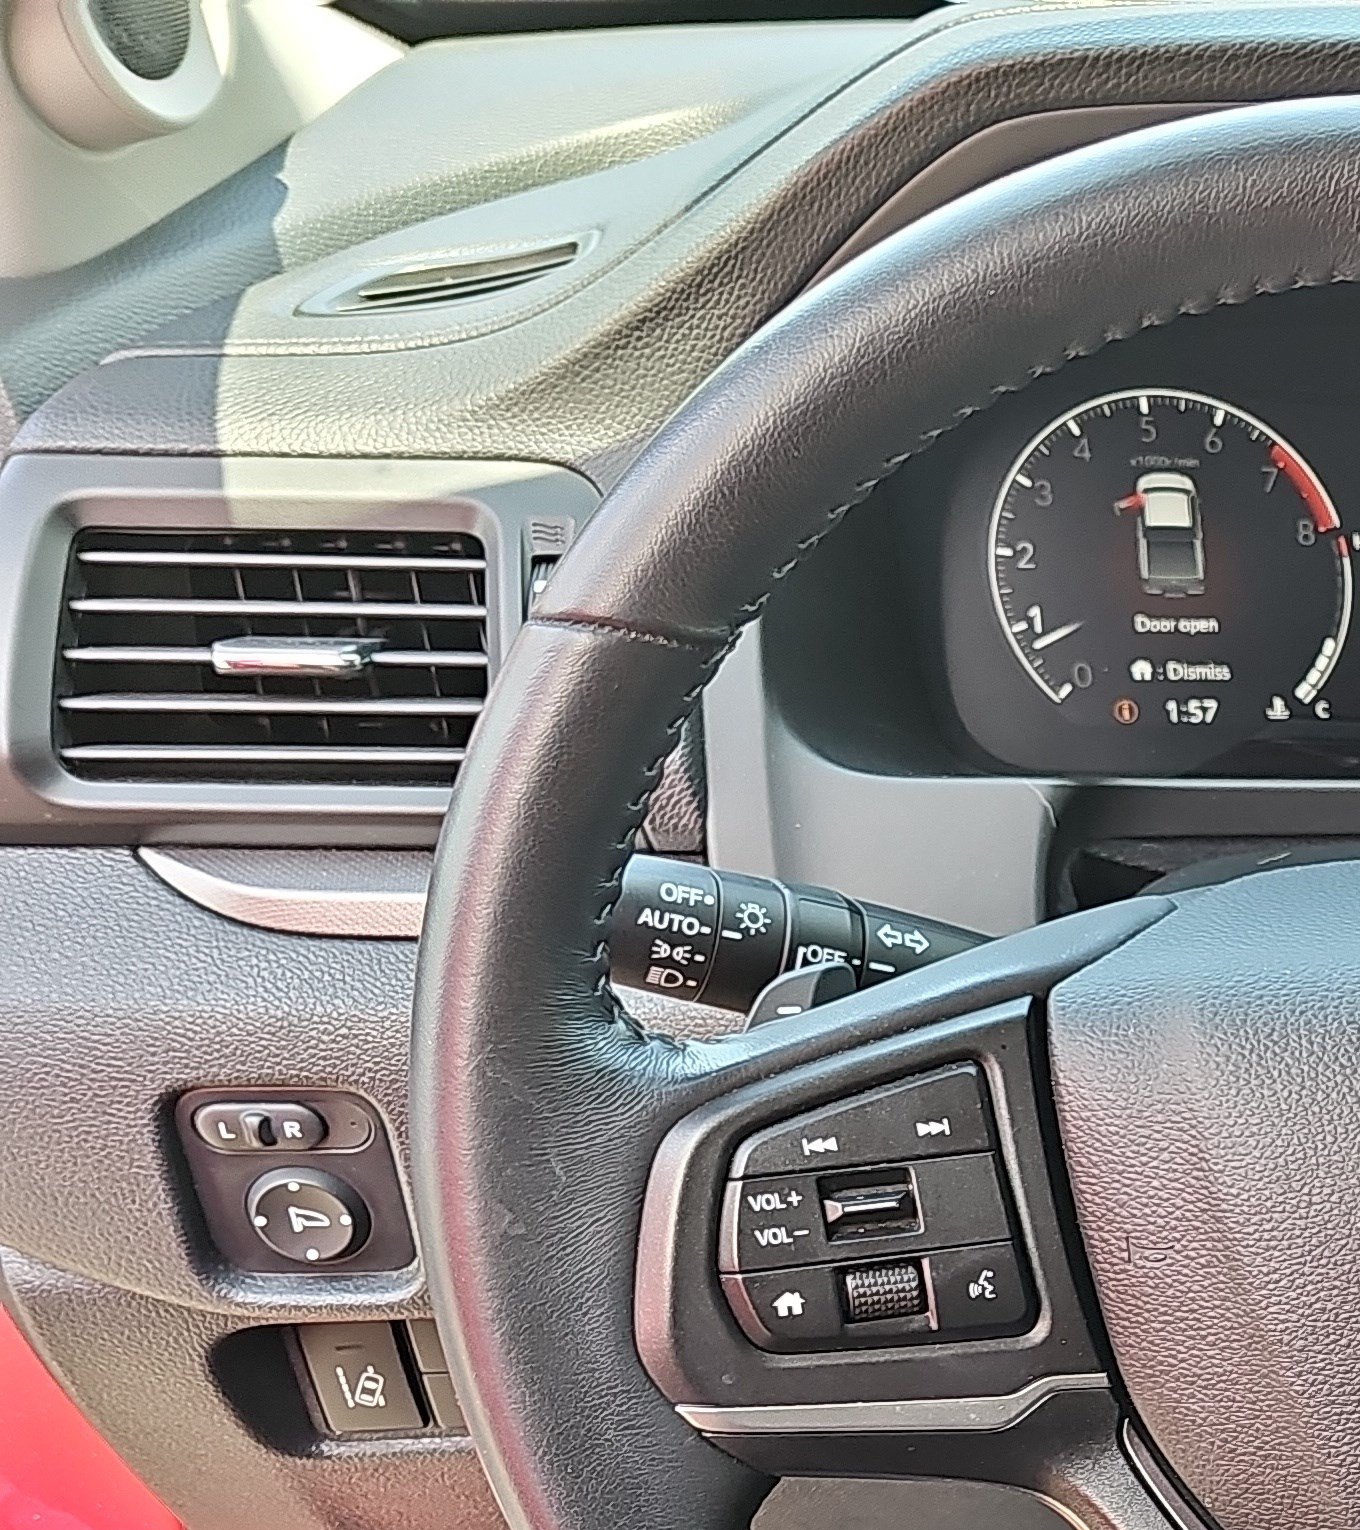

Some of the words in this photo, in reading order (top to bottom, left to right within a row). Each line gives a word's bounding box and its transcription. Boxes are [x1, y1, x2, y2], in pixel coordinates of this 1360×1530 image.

[1141, 418, 1157, 441] 5
[1073, 439, 1092, 461] 4
[1204, 431, 1223, 454] 6
[1261, 468, 1279, 493] 7
[1033, 482, 1053, 505] 3
[1297, 520, 1316, 546] 8
[1016, 543, 1037, 569] 2
[1026, 606, 1043, 633] 1
[1134, 614, 1175, 634] Door
[1178, 617, 1219, 637] open
[1073, 664, 1092, 687] 0
[1166, 661, 1233, 682] Dismiss
[1165, 699, 1220, 725] 1:57
[1315, 700, 1332, 719] C
[659, 882, 703, 905] OFF
[637, 908, 702, 936] AUTO
[806, 944, 848, 964] OFF
[217, 1121, 236, 1140] L
[283, 1121, 304, 1139] R
[747, 1191, 803, 1213] VOL+
